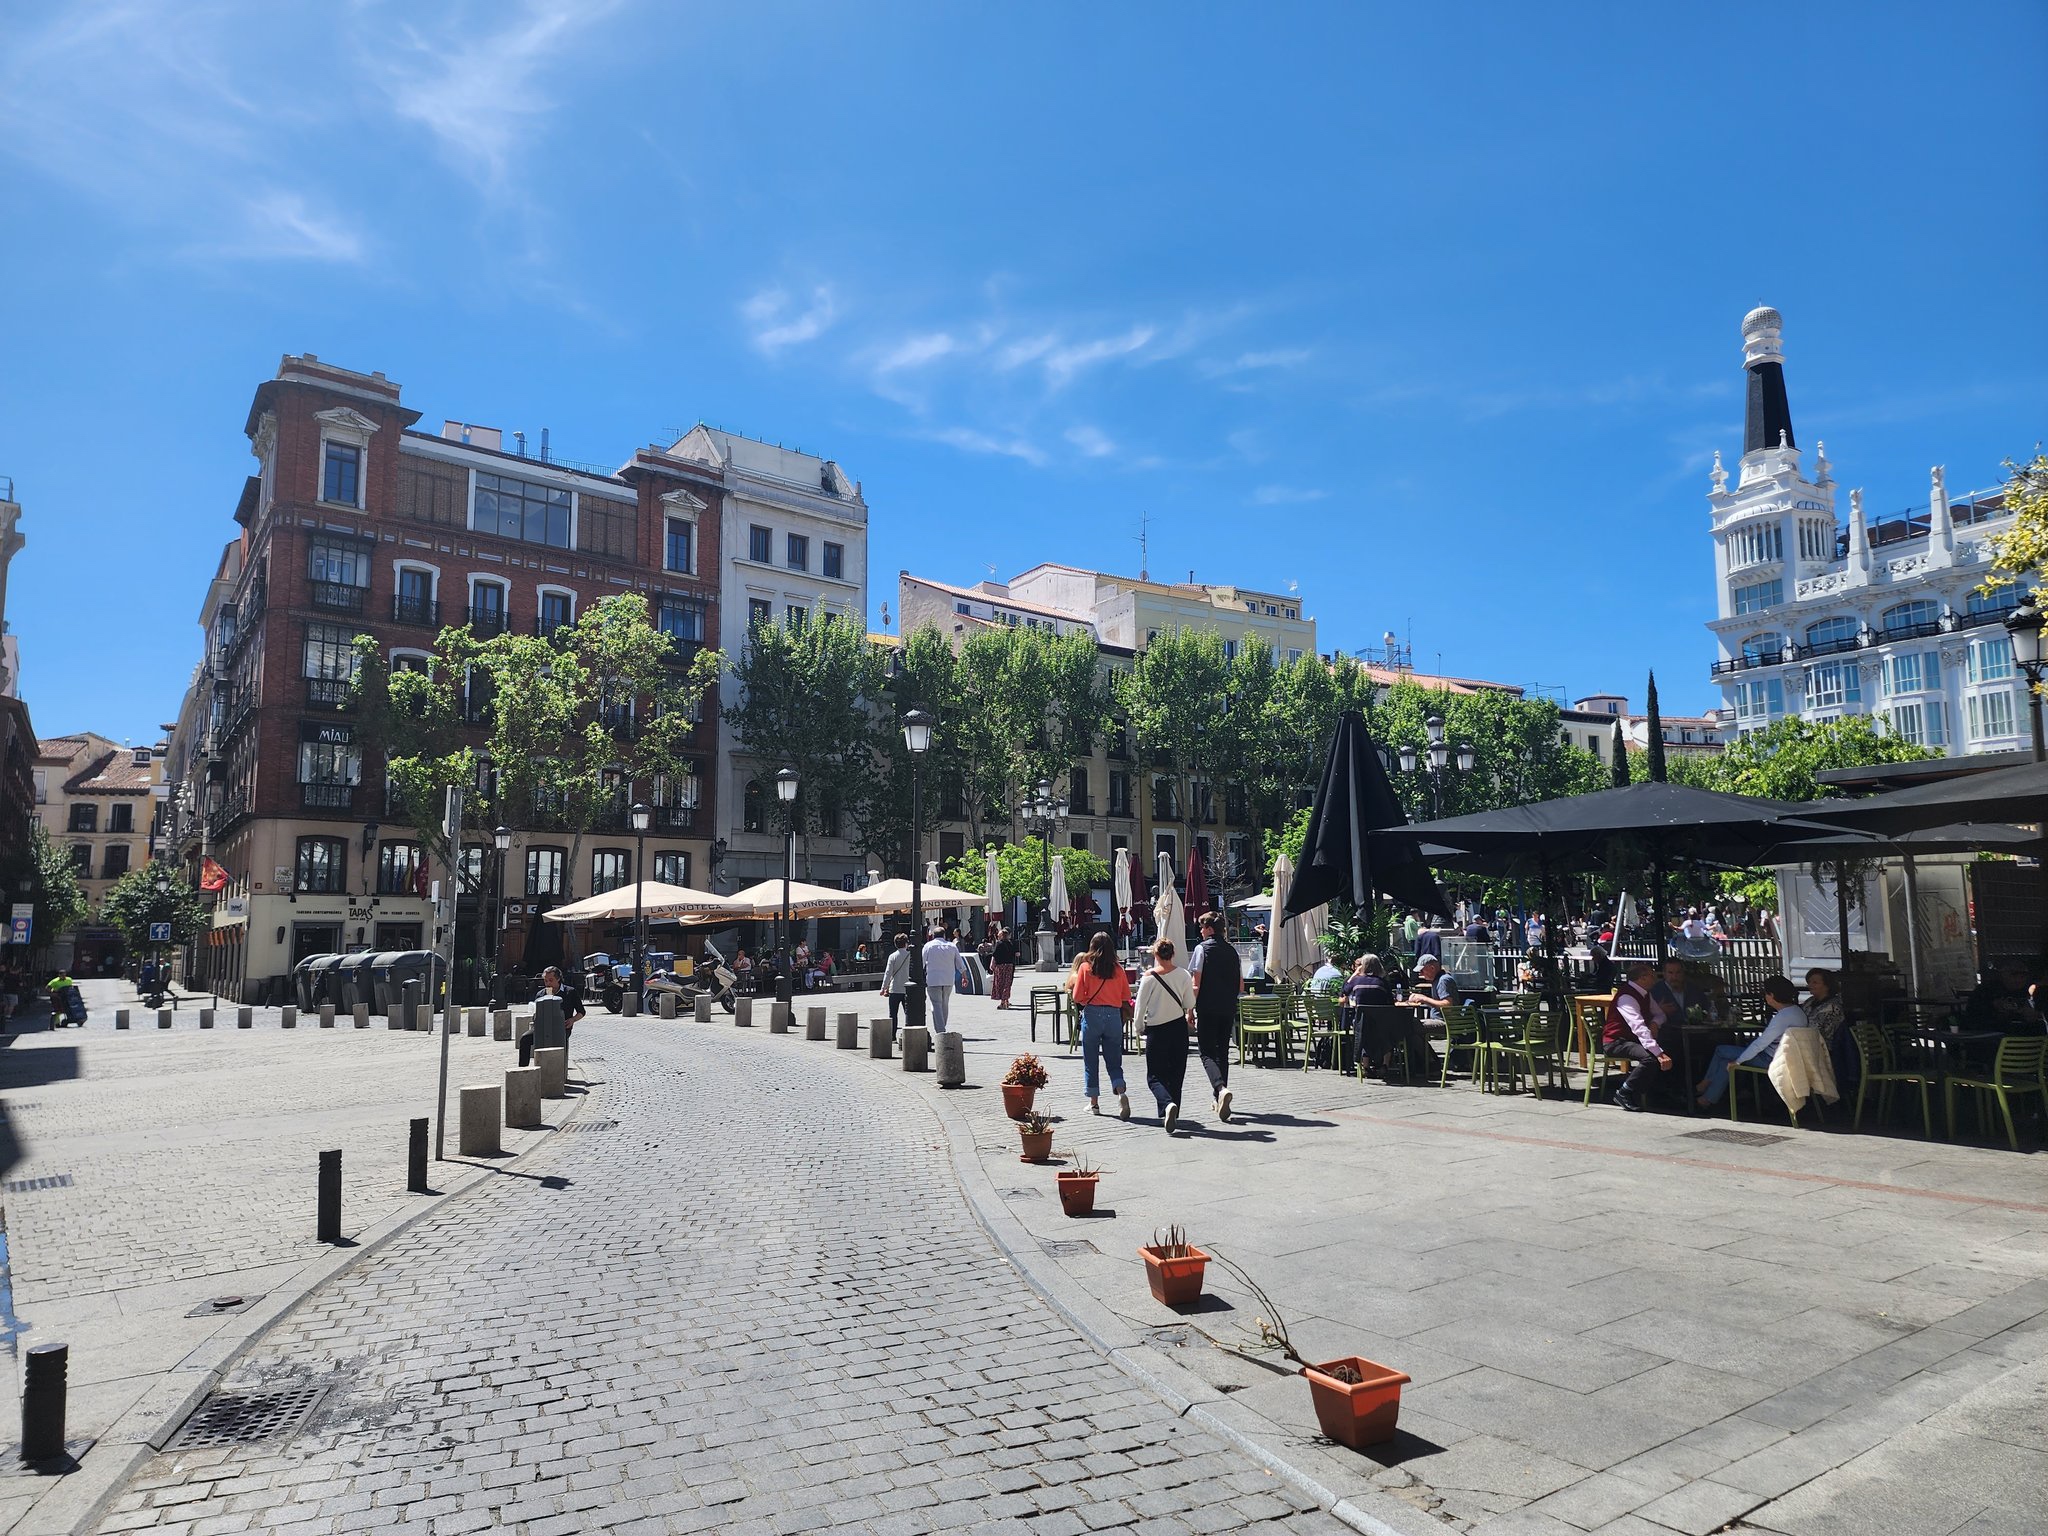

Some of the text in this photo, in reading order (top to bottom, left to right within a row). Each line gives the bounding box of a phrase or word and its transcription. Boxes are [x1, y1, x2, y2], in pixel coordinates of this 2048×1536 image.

[667, 904, 723, 912] VINOTECA
[801, 900, 849, 908] VINOTECA
[920, 900, 963, 908] VINOTECA
[348, 905, 373, 922] TAPAS
